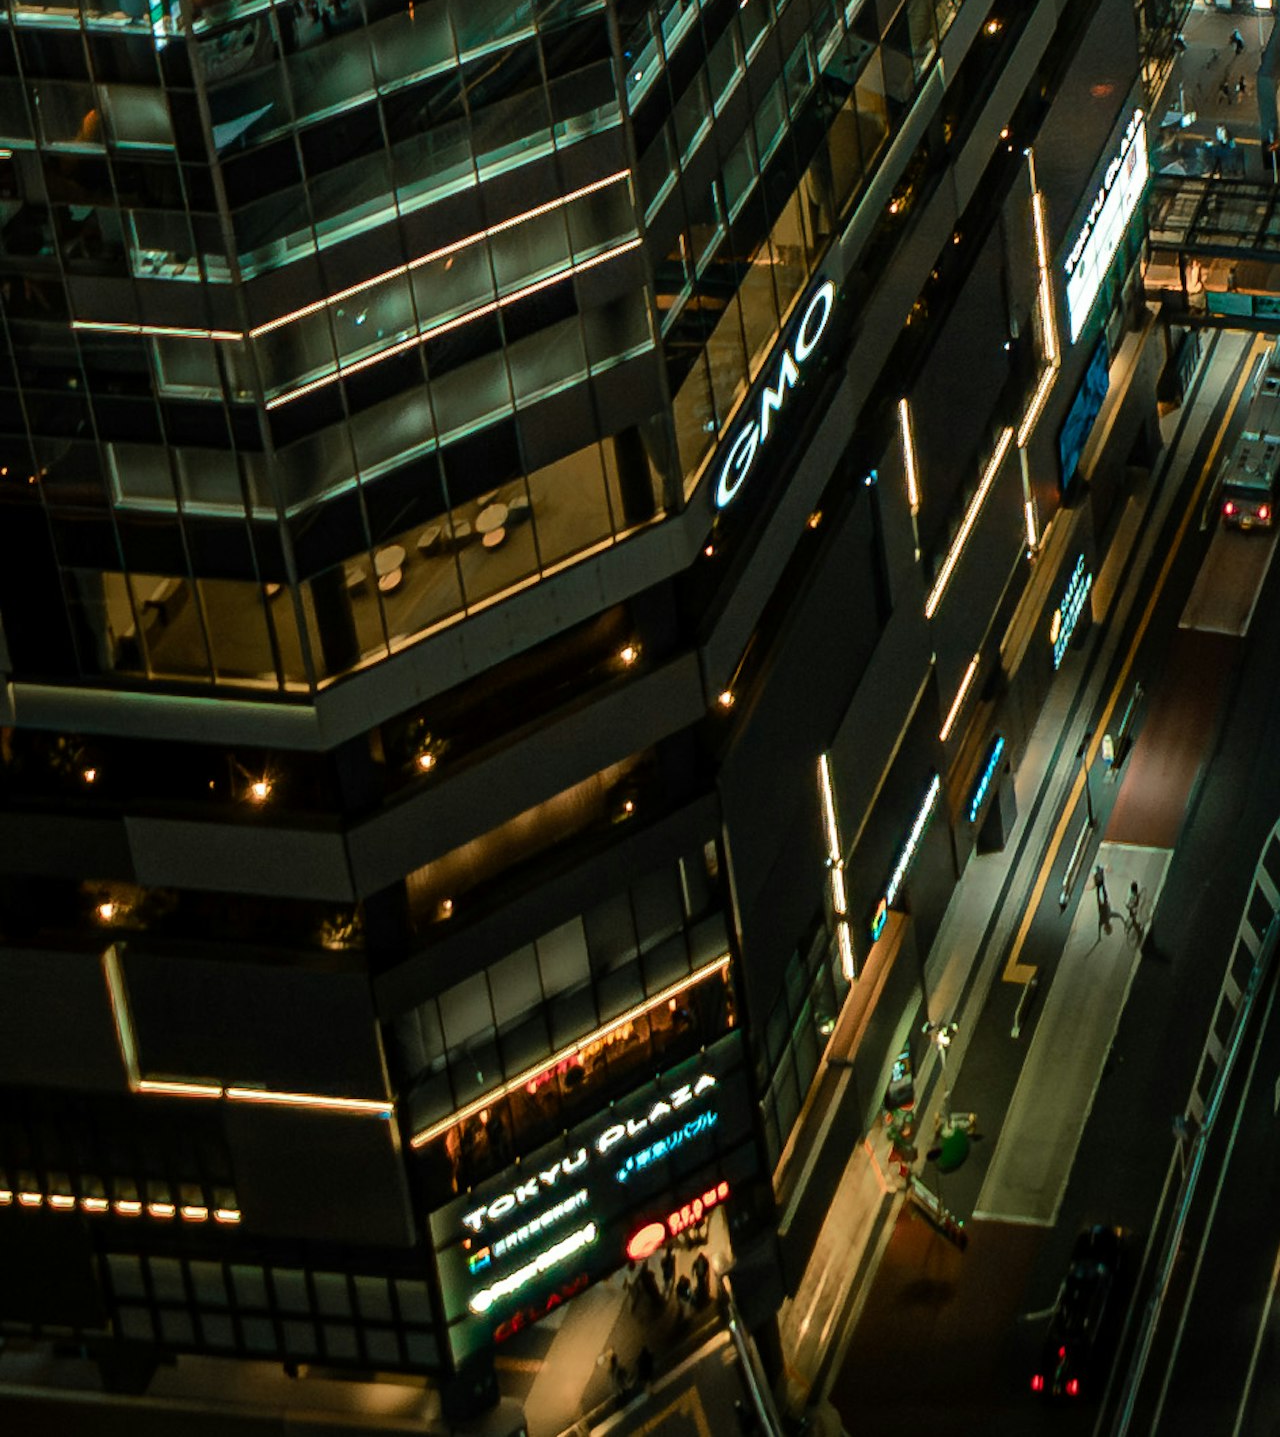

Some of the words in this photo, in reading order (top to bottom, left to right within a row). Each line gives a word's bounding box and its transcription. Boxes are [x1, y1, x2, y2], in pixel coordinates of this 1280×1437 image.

[715, 280, 836, 509] GMO
[462, 1147, 588, 1233] TOKYU
[598, 1074, 716, 1154] PLAZA
